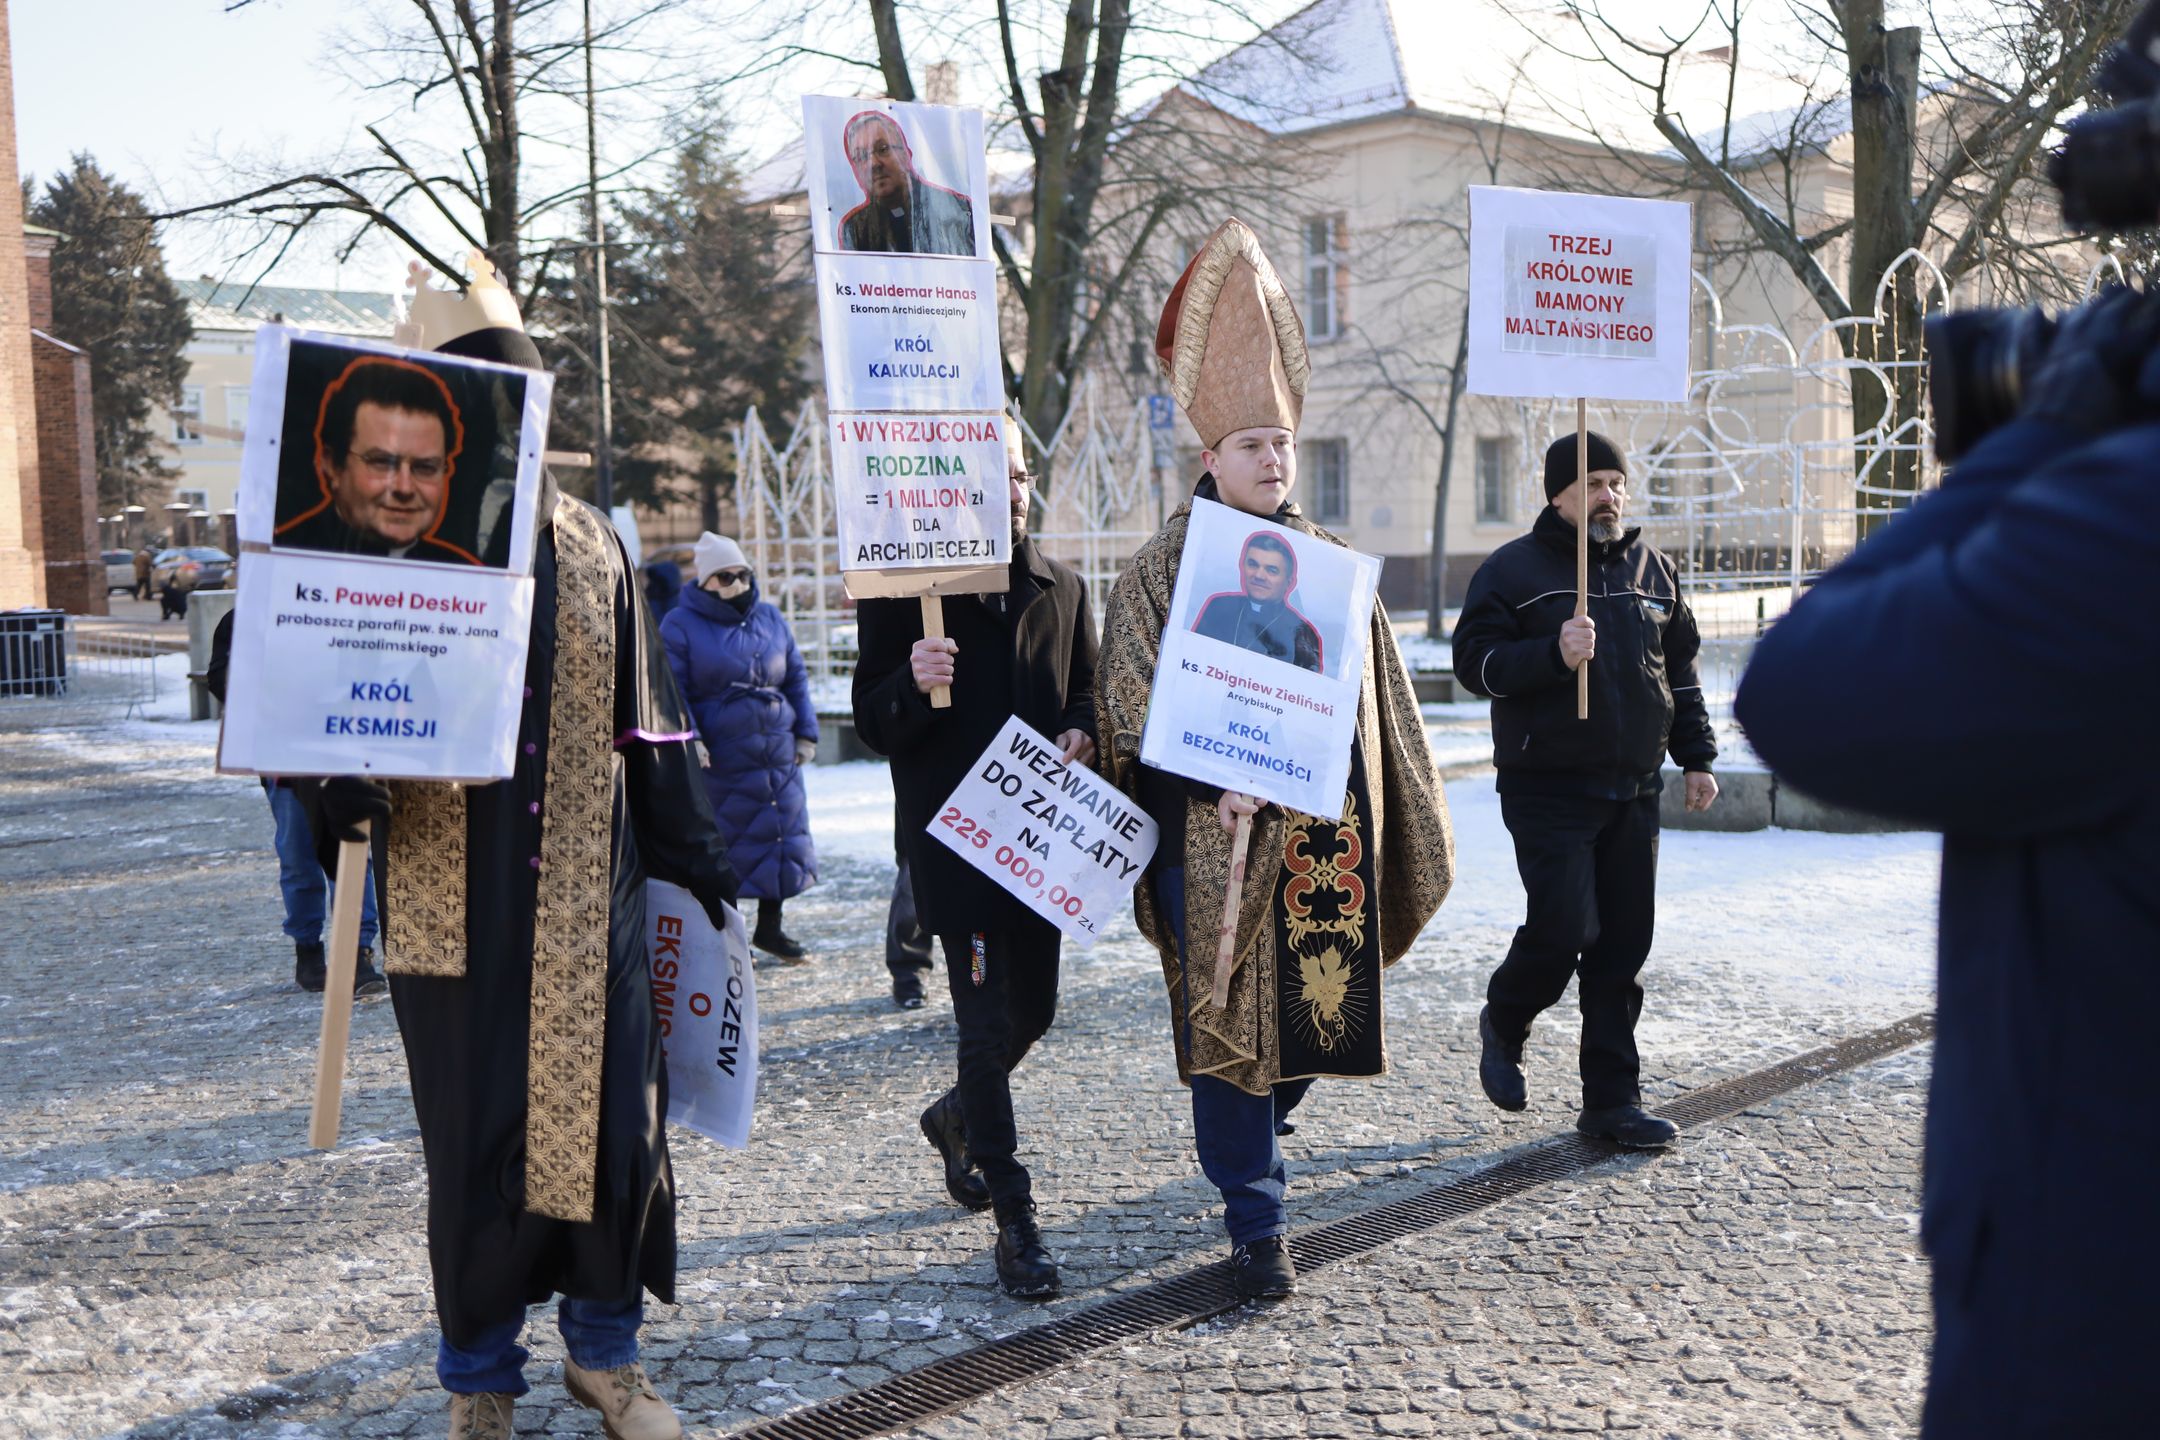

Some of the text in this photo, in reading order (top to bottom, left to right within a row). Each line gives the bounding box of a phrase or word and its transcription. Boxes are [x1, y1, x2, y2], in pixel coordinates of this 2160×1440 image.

[1549, 234, 1612, 256] TRZEJ
[1527, 260, 1633, 286] KRÓLOWIE
[836, 283, 977, 300] ks. Waldemar Hanas
[1535, 291, 1625, 313] MAMONY
[850, 305, 966, 318] Ekonom Archidiecezjalny
[1505, 317, 1654, 343] MALTAŃSKIEGO
[894, 335, 933, 353] KRÓL
[869, 363, 960, 379] KALKULACJI
[837, 421, 998, 443] 1 WYRZUCONA
[866, 456, 966, 477] RODZINA
[884, 490, 893, 509] 1
[900, 488, 967, 508] MILION
[972, 489, 984, 505] zł
[913, 518, 940, 532] DLA
[857, 539, 995, 562] ARCHIDIECEZJI
[295, 582, 488, 615] ks. Paweł Deskur
[276, 612, 499, 639] proboszcz parafii pw. św. Jana
[328, 637, 448, 657] Jerozolimskiego
[351, 677, 413, 703] KRÓL
[1181, 658, 1334, 717] ks. Zbigniew Zieliński
[1227, 691, 1284, 716] Arcybiskup
[325, 715, 437, 739] EKSMISJI
[1227, 720, 1271, 745] KRÓL
[1182, 731, 1311, 782] BEZCZYNNOŚCI
[1009, 732, 1144, 842] WEZWANIE
[981, 759, 1139, 880] DO ZAPŁATY
[1017, 827, 1050, 861] NA
[940, 807, 992, 849] 225
[994, 845, 1082, 917] 000,00
[689, 992, 711, 1017] O
[717, 954, 743, 1078] POZEW
